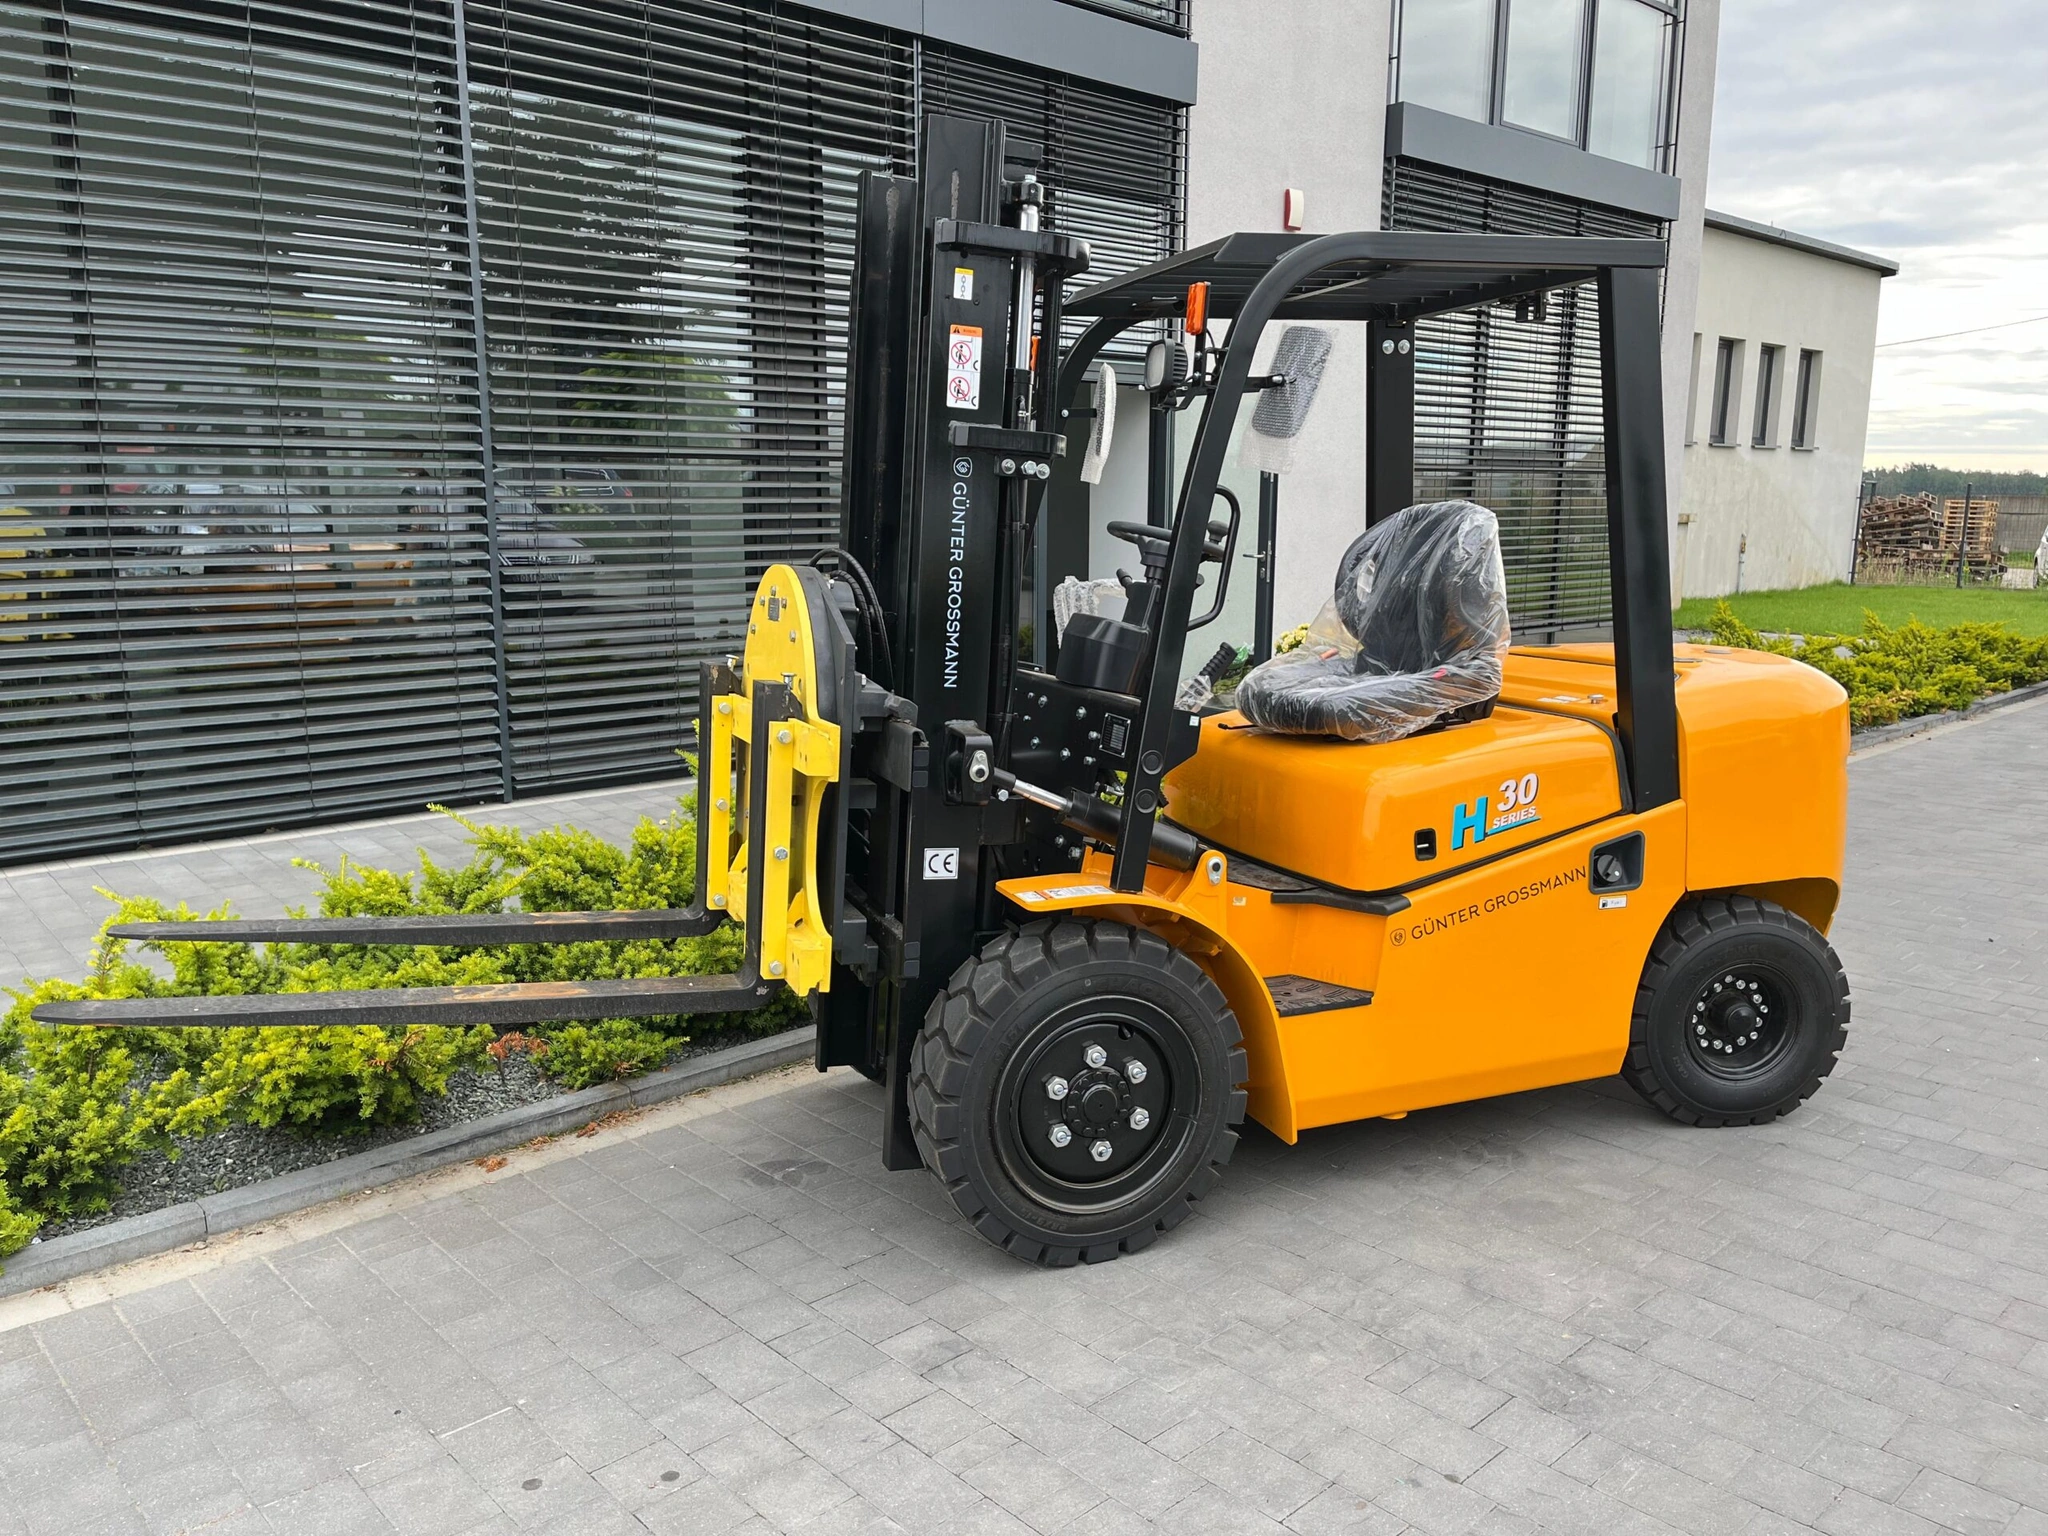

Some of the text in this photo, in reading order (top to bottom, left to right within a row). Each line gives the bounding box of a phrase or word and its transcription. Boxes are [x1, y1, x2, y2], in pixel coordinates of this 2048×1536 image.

[943, 482, 970, 688] GÜNTER GROSSMANN
[1497, 773, 1538, 811] 30
[1451, 796, 1489, 850] H
[1493, 806, 1536, 829] SERIES
[928, 853, 954, 874] CE
[1411, 866, 1587, 940] GÜNTER GROSSMANN
